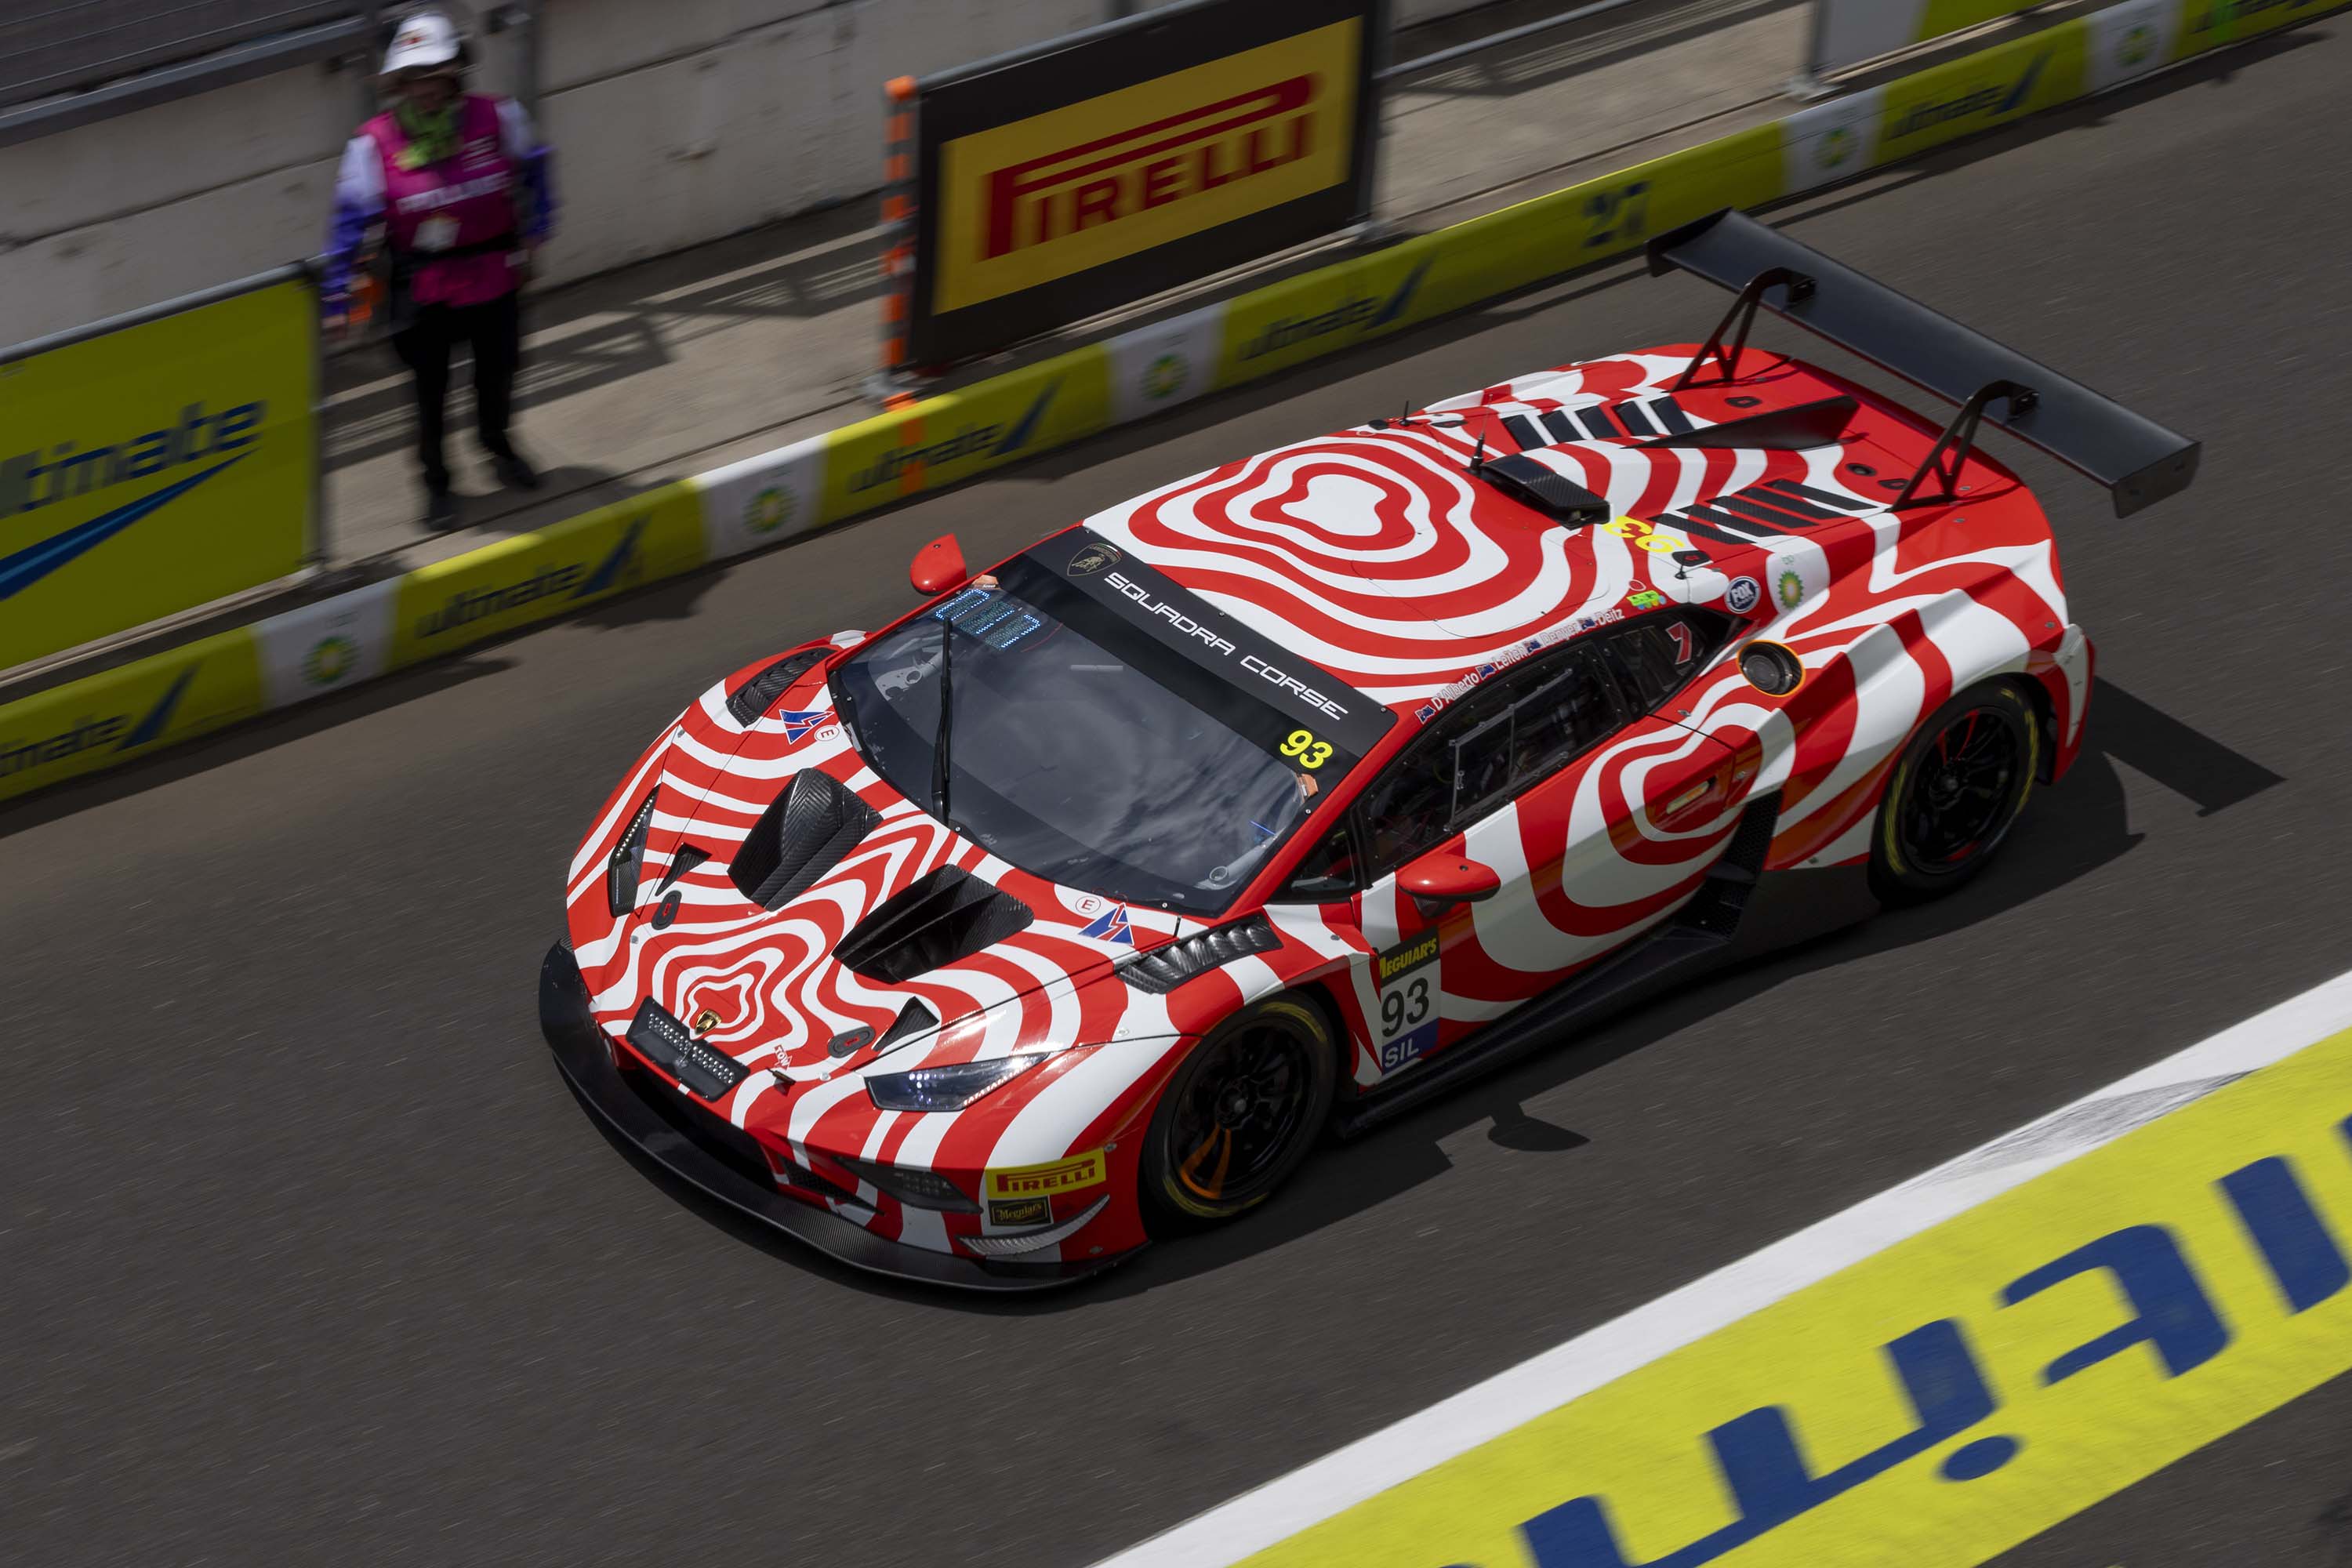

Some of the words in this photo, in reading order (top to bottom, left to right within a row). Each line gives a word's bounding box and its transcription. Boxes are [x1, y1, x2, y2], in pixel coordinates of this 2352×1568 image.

[980, 71, 1322, 260] PIRELLI
[1731, 582, 1754, 603] FOX
[1105, 571, 1235, 656] SQUADRA
[1240, 654, 1348, 720] CORSE
[1431, 670, 1480, 711] D'Alberto
[1493, 644, 1532, 671] Leitch
[1595, 607, 1625, 626] Deitz
[1279, 729, 1333, 769] 93
[1081, 899, 1094, 910] E
[1381, 978, 1429, 1037] 93
[775, 1047, 789, 1066] TOW
[1385, 1038, 1419, 1067] SIL
[996, 1159, 1095, 1192] PIRELLI
